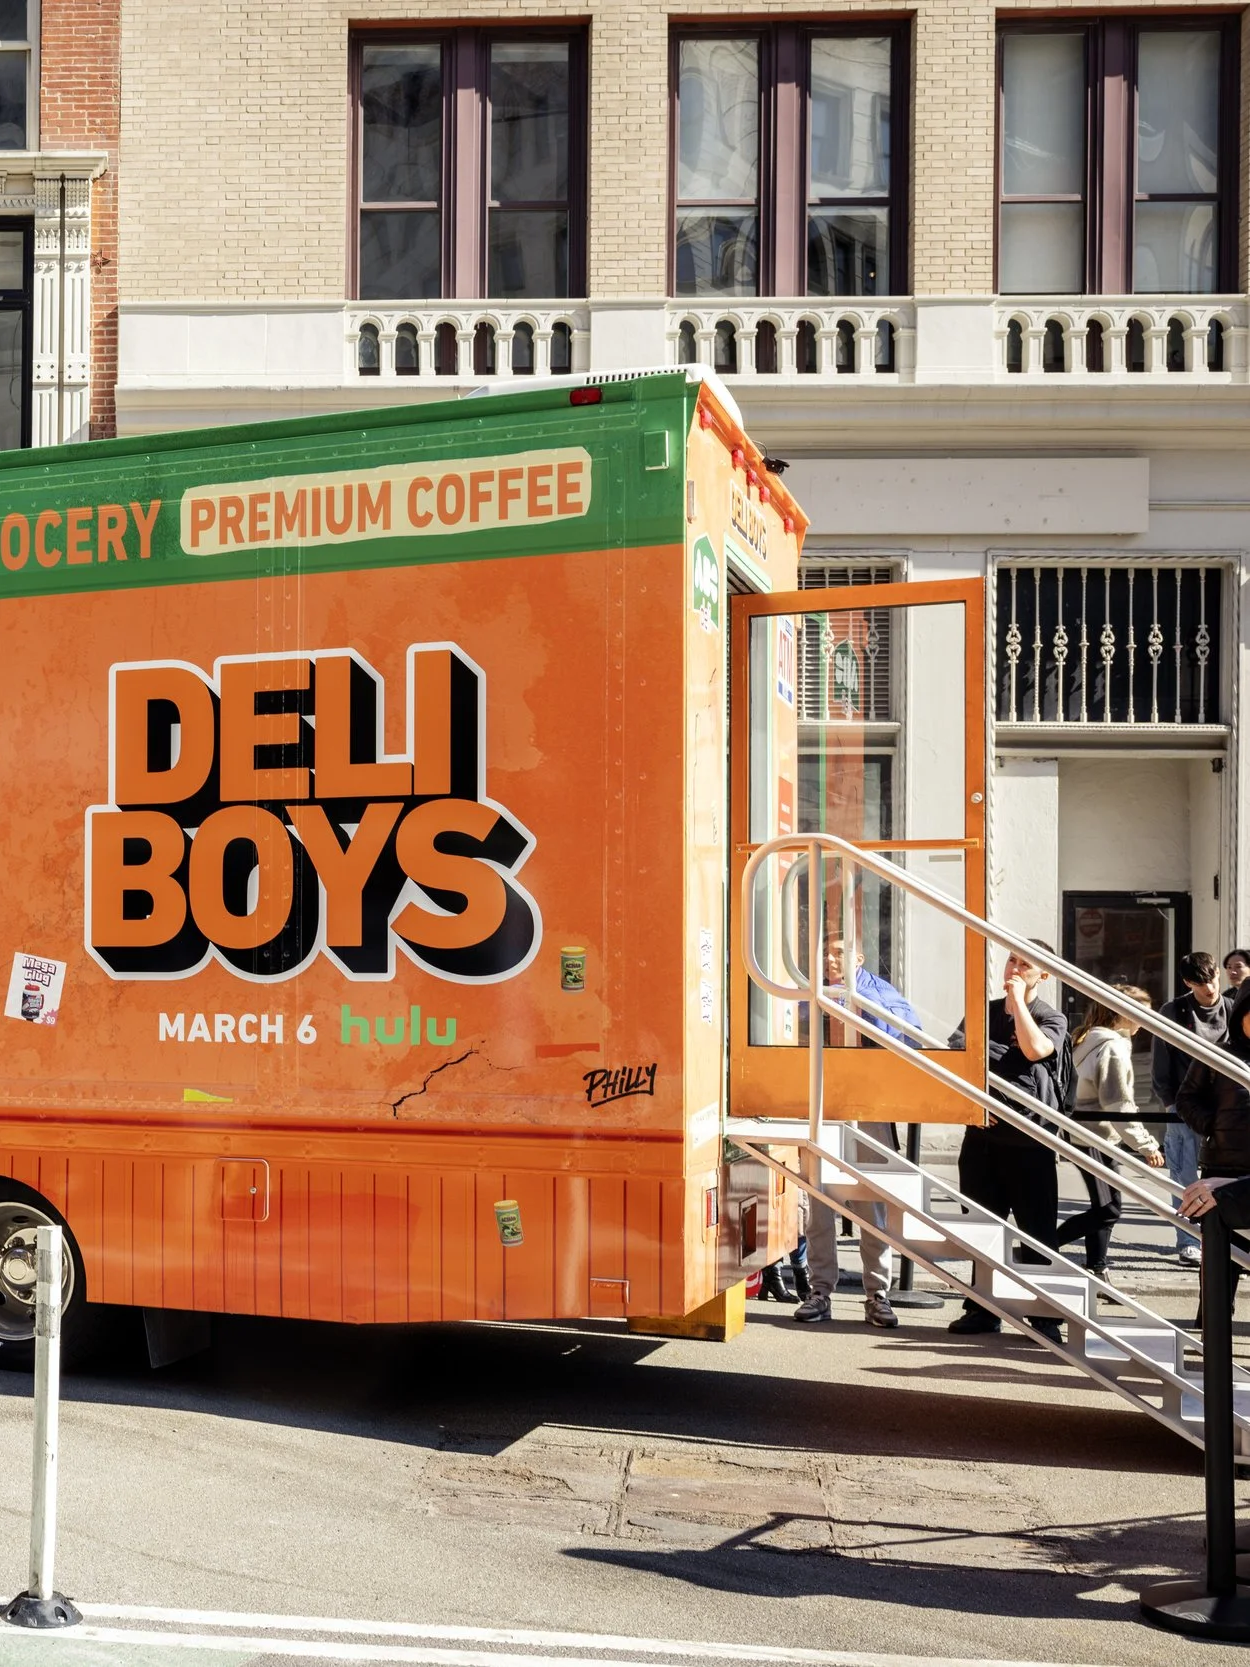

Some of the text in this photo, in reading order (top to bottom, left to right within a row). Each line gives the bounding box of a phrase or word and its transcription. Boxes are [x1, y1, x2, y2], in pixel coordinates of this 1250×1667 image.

[190, 480, 392, 548] PREMIUM
[406, 460, 584, 529] COFFEE
[111, 646, 474, 806] DELI
[88, 797, 526, 966] BOYS
[22, 956, 56, 975] Mega
[24, 969, 51, 987] Glug
[45, 1016, 56, 1025] $9
[158, 1004, 457, 1046] MARCH 6 hulu
